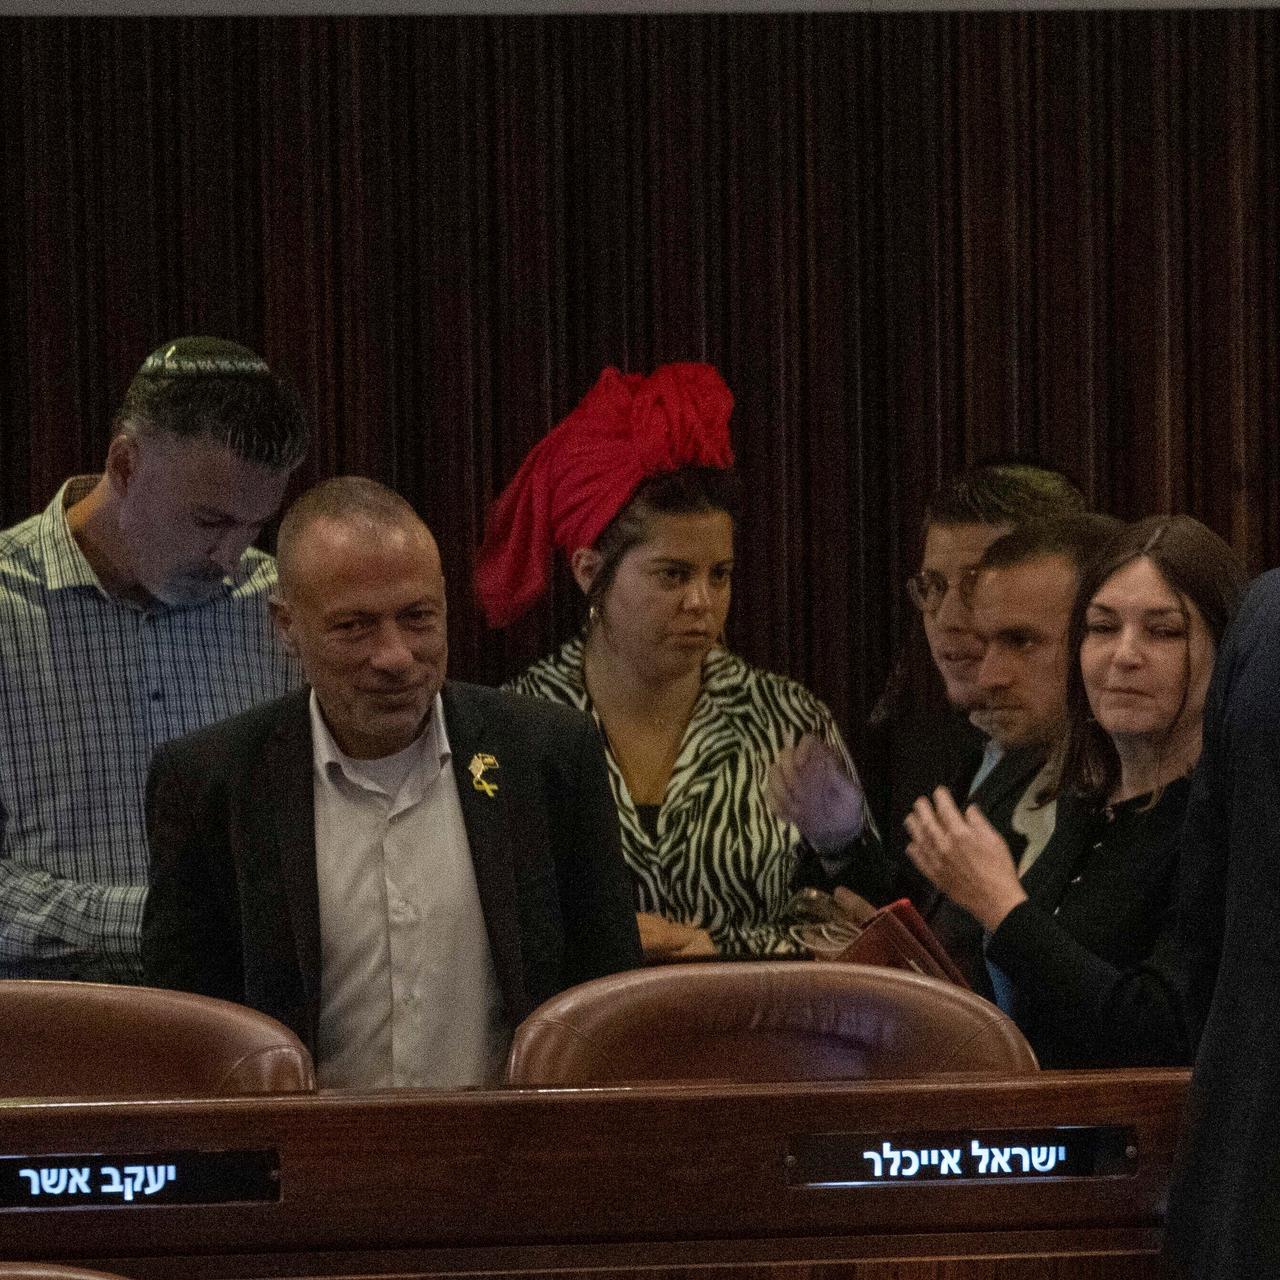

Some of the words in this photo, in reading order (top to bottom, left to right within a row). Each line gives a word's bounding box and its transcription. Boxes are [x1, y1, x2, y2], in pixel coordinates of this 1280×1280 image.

[863, 1141, 962, 1177] אייכלר
[970, 1139, 1066, 1174] ישראל
[18, 1167, 92, 1196] אשר
[100, 1164, 177, 1201] יעקב
